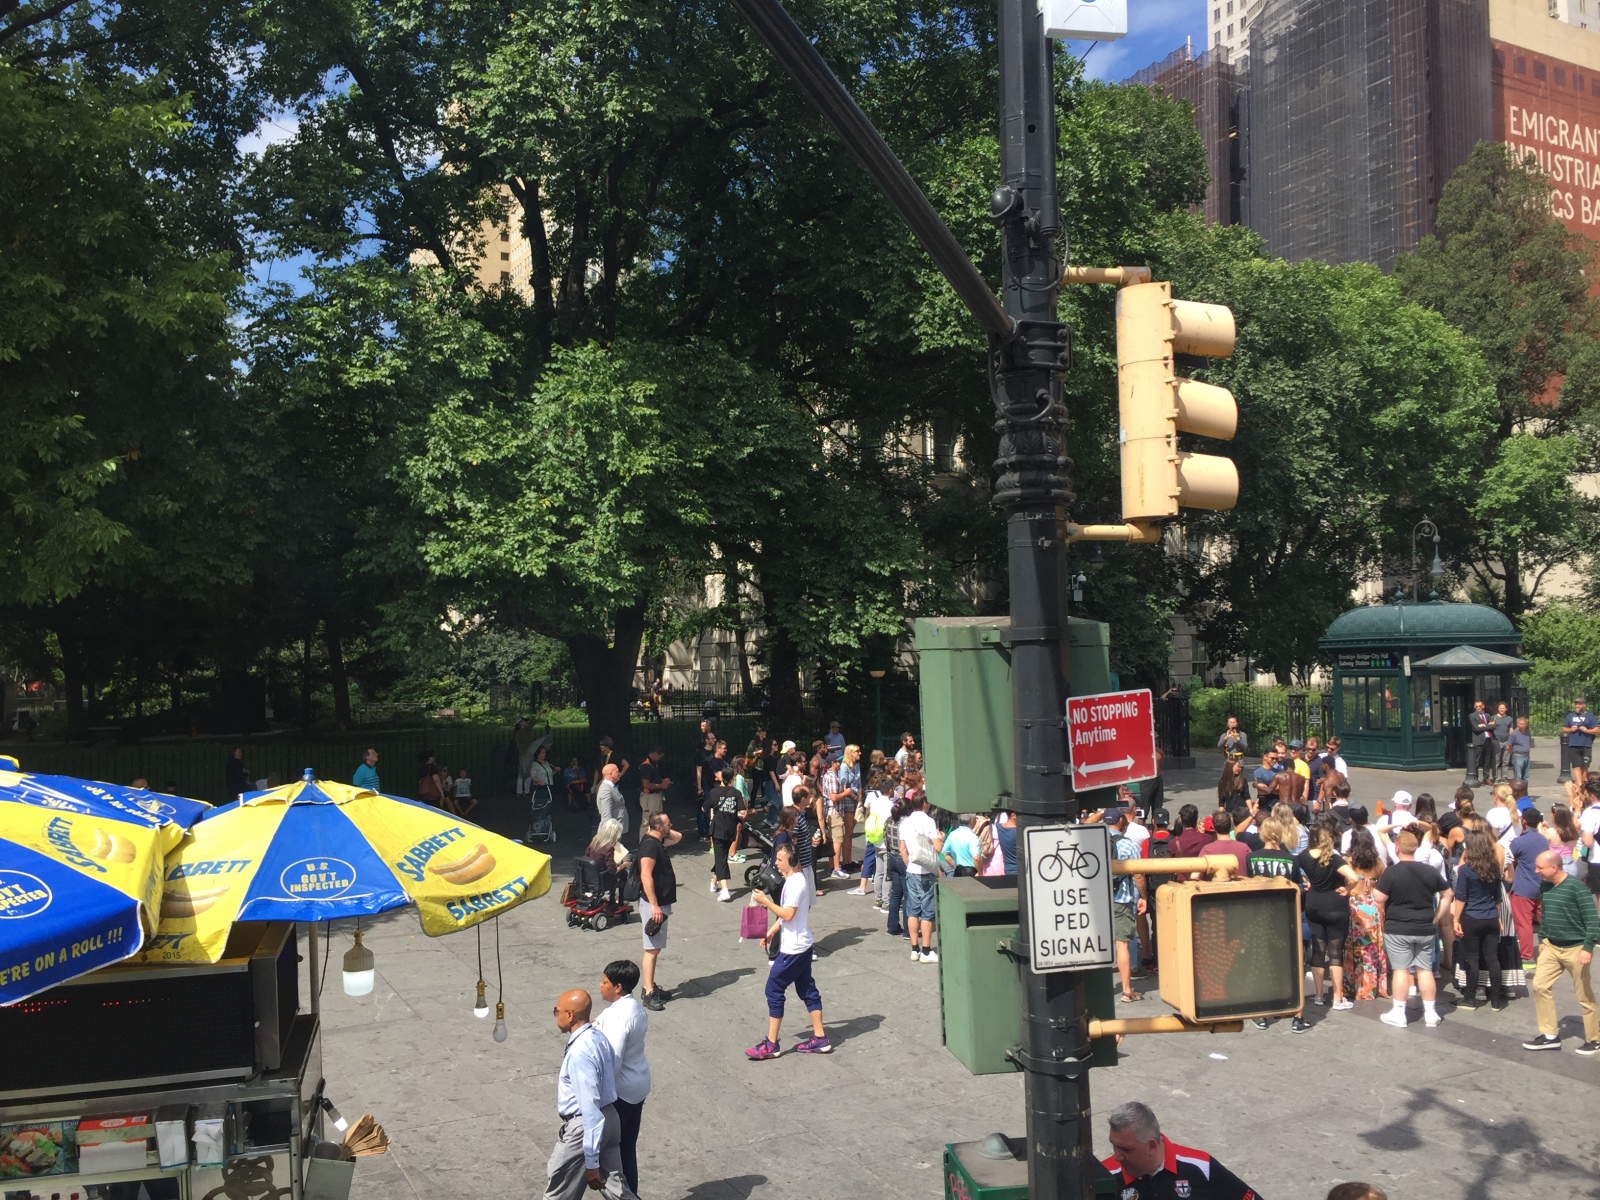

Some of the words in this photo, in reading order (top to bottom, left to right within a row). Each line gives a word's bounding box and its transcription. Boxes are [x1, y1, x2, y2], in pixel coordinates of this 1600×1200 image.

[1509, 105, 1600, 156] EMIGRAN
[1072, 706, 1088, 725] NO
[1090, 700, 1139, 722] STOPPING
[1075, 726, 1117, 747] Anytime
[396, 827, 466, 882] SABRETT
[306, 862, 330, 872] U.S.
[290, 879, 349, 893] INSPECTED
[301, 871, 337, 885] GOV'T
[446, 876, 528, 921] SABRETT
[1053, 887, 1090, 907] USE
[1055, 912, 1090, 931] PED
[34, 951, 55, 972] ON
[59, 947, 68, 964] A
[71, 934, 104, 959] ROLL
[162, 951, 182, 960] 2015
[1040, 935, 1108, 957] SIGNAL
